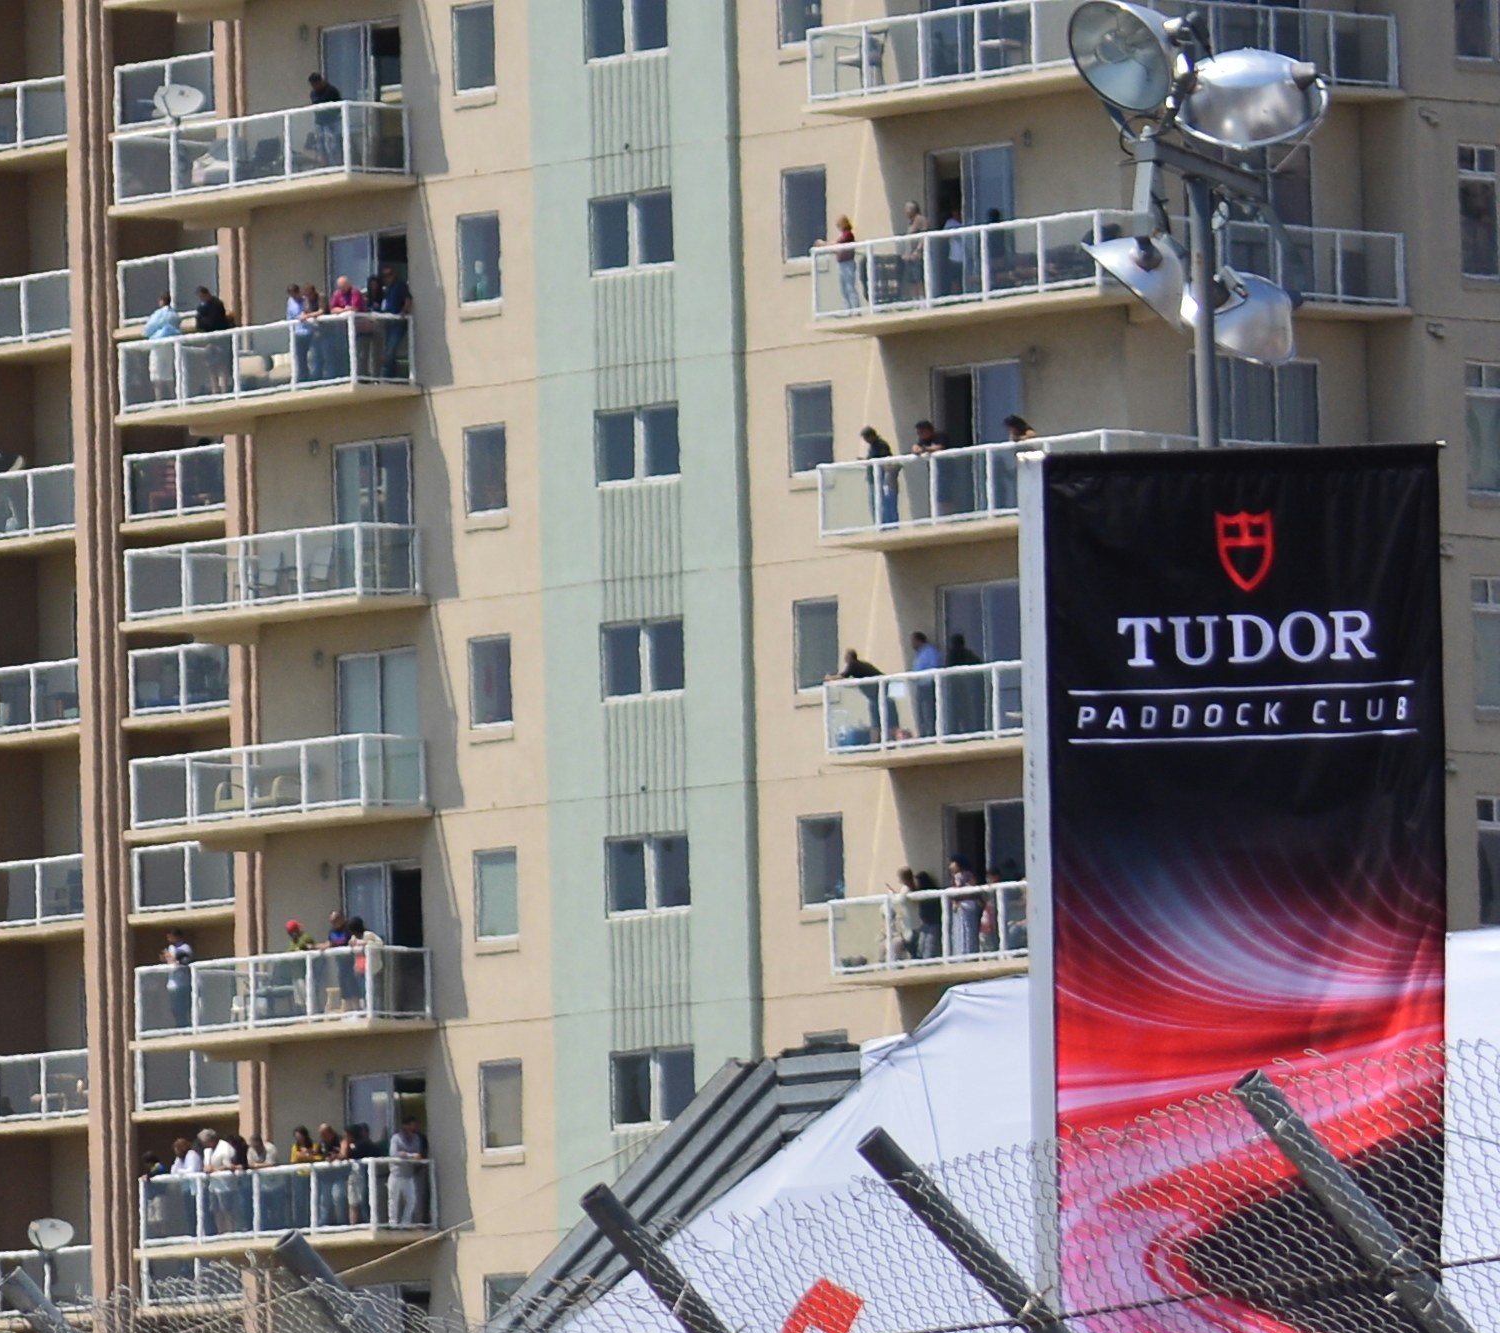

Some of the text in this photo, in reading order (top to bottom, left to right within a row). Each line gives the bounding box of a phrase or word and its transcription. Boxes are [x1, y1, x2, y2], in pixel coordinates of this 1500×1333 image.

[1117, 608, 1378, 668] TUDOR
[1077, 695, 1407, 730] PADDOCK CLUB
